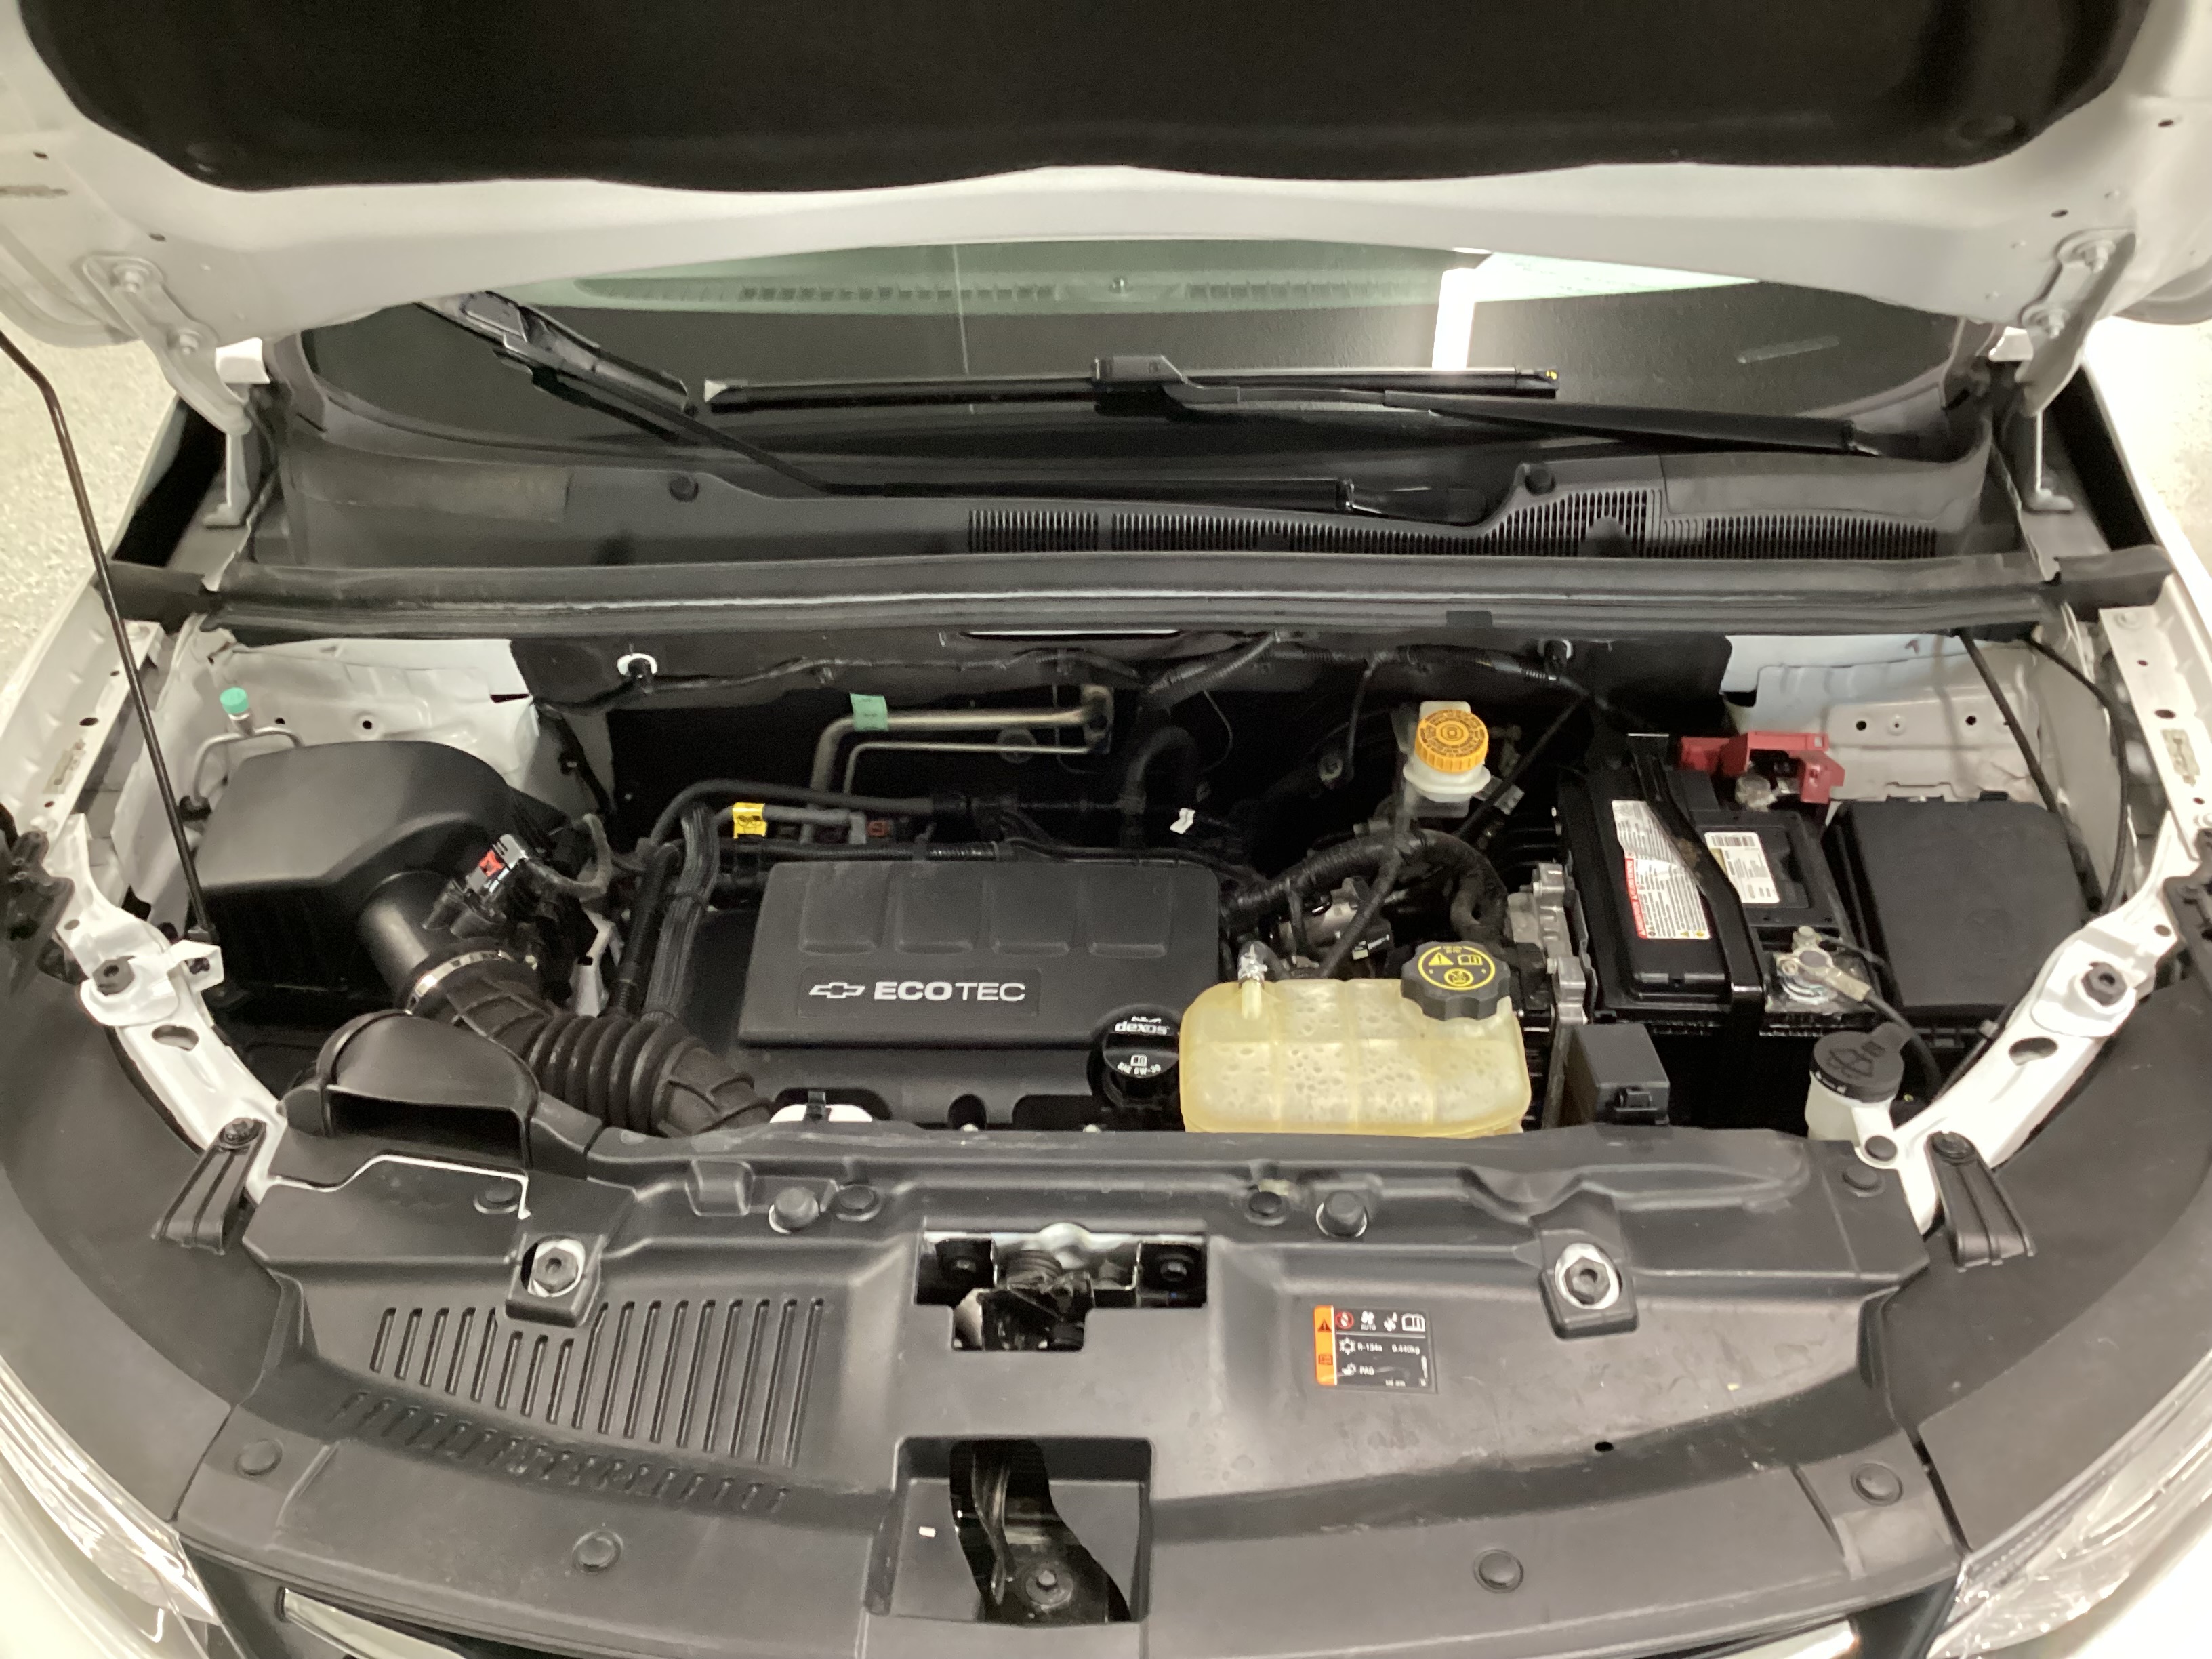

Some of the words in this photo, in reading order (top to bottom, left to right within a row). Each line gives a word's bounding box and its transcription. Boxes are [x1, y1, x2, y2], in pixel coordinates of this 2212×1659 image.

[874, 981, 1026, 1002] ECOTEC
[1115, 1021, 1167, 1035] dexos
[1359, 1366, 1374, 1375] PAG
